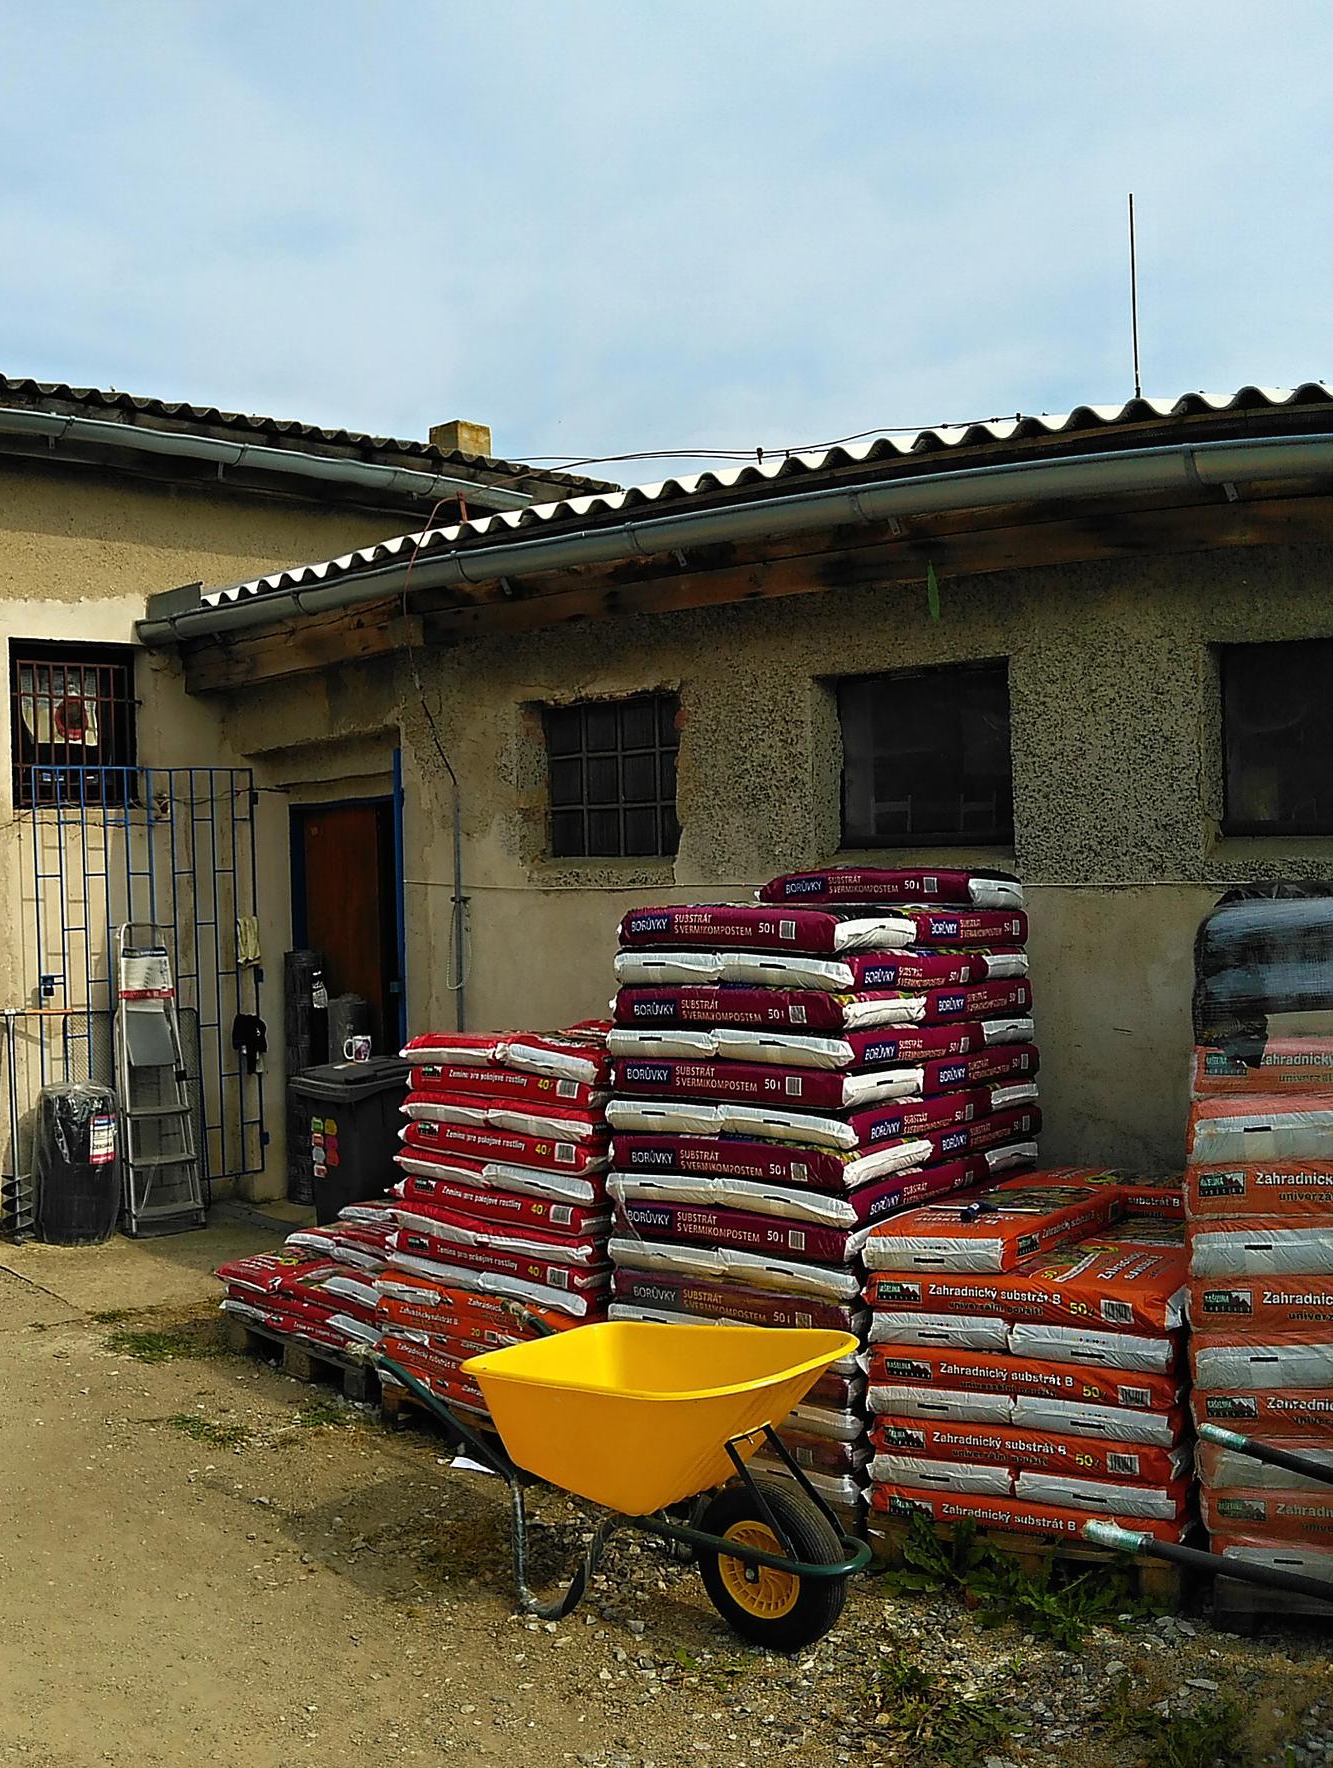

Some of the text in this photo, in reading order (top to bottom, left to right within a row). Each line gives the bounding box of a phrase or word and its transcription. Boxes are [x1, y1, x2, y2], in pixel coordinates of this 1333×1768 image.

[828, 875, 861, 884] SUBSTRÁT
[786, 880, 822, 894] BORŮVKY
[834, 885, 899, 893] VERMIKOMPOSTEM
[631, 917, 668, 932] BORŮVKY
[674, 913, 712, 923] SUBSTRÁT
[680, 925, 752, 936] VERMIKOMPOSTEM
[634, 1001, 674, 1016] BORŮVKY
[681, 1000, 718, 1009] SUBSTRÁT
[688, 1011, 762, 1022] VERMIKOMPOSTEM
[627, 1067, 668, 1081] BORŮVKY
[675, 1066, 715, 1077] SUBSTRÁT
[681, 1078, 757, 1092] VERMIKOMPOSTEM
[632, 1151, 673, 1164] BORŮVKY
[680, 1150, 719, 1161] SUBSTRÁT
[687, 1162, 763, 1177] VERMIKOMPOSTEM
[627, 1210, 670, 1226] BORŮVKY
[677, 1211, 717, 1224] SUBSTRÁT
[683, 1223, 760, 1243] VERMIKOMPOSTEM
[633, 1286, 676, 1301] BORŮVKY
[684, 1289, 723, 1303] SUBSTRÁT
[929, 1284, 997, 1300] Zahradnický
[1000, 1289, 1050, 1303] substrát
[940, 1363, 1073, 1387] Zahradnický substrát B
[933, 1431, 1066, 1455] Zahradnický substrát B
[942, 1503, 1076, 1531] Zahradnický substrát B
